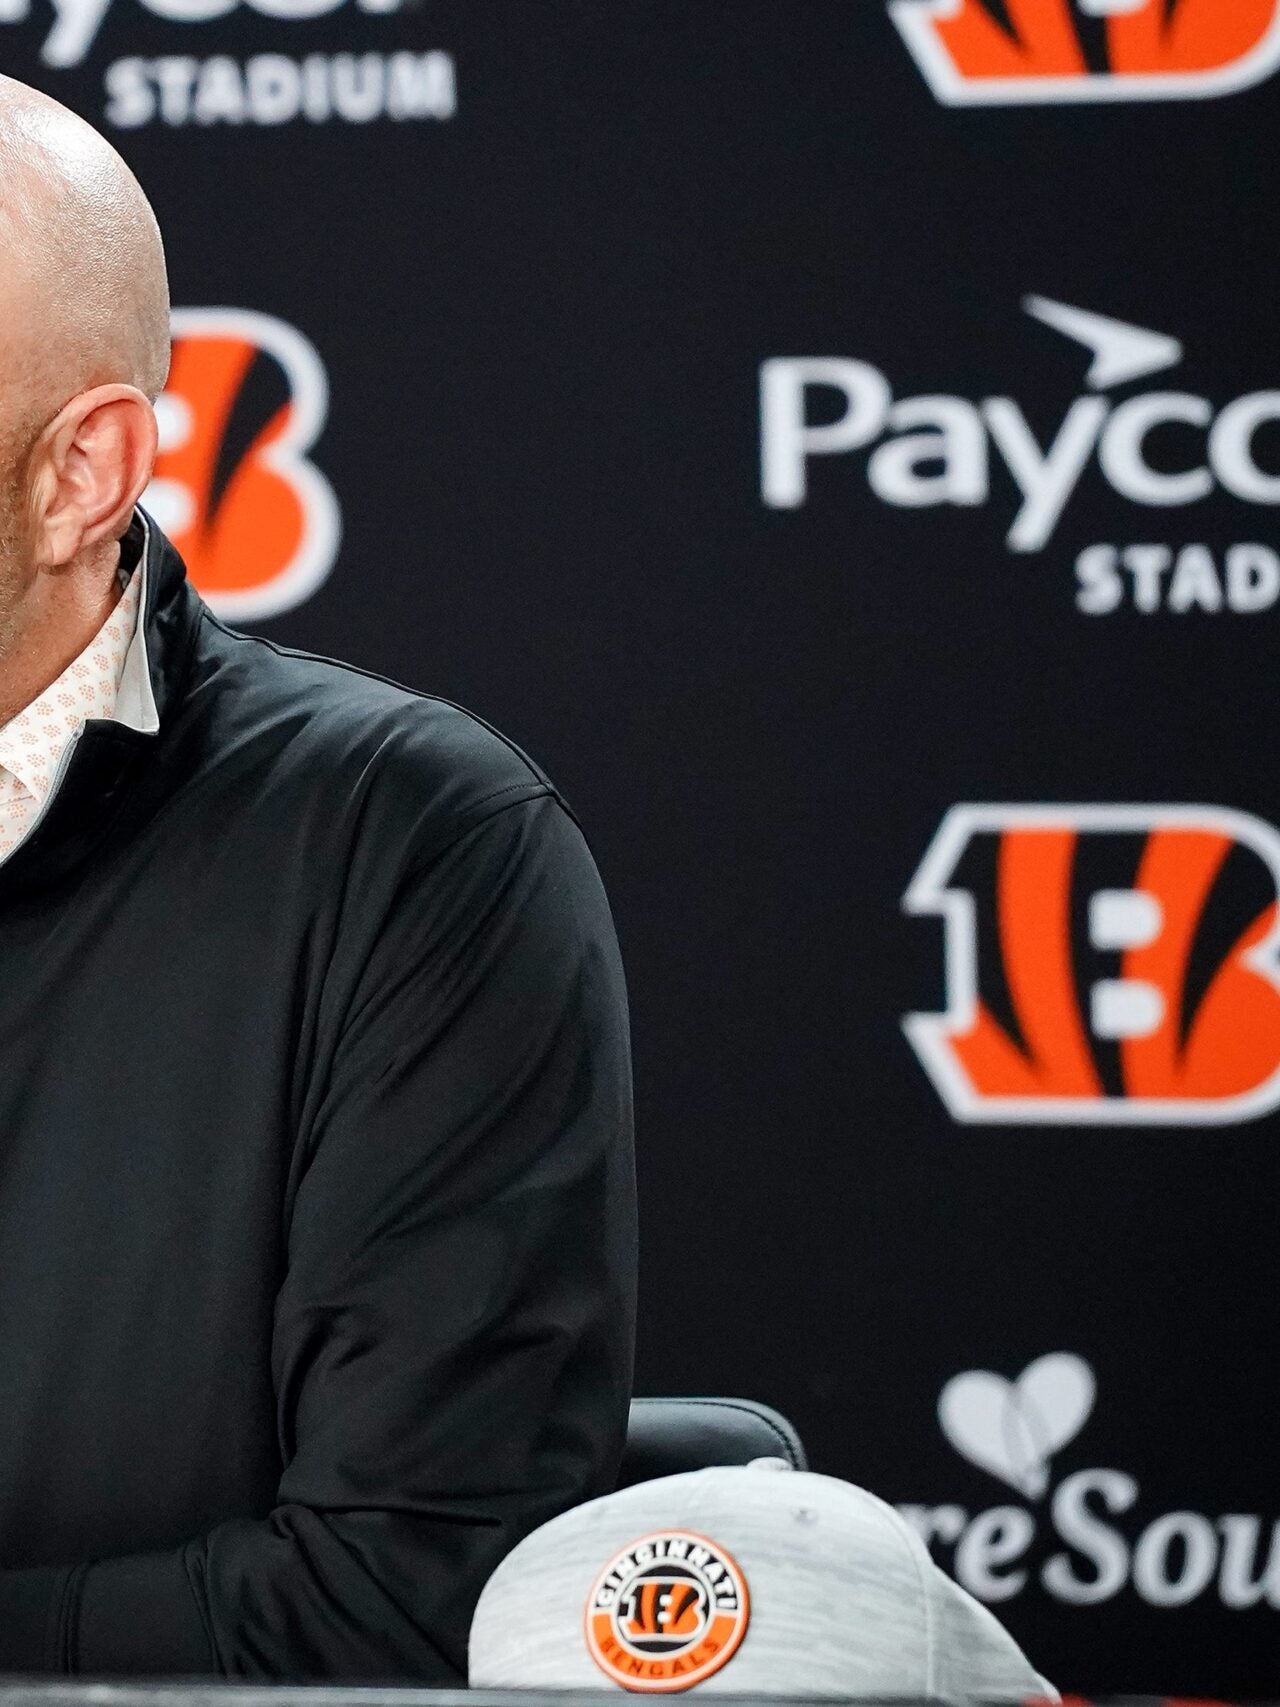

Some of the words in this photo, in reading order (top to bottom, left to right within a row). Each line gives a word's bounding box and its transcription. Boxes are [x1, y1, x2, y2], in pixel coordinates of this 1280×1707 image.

[105, 50, 458, 128] STADIUM
[1074, 542, 1280, 616] STAD
[596, 1538, 738, 1608] CINCINNATI
[598, 1635, 721, 1677] BENGALS
